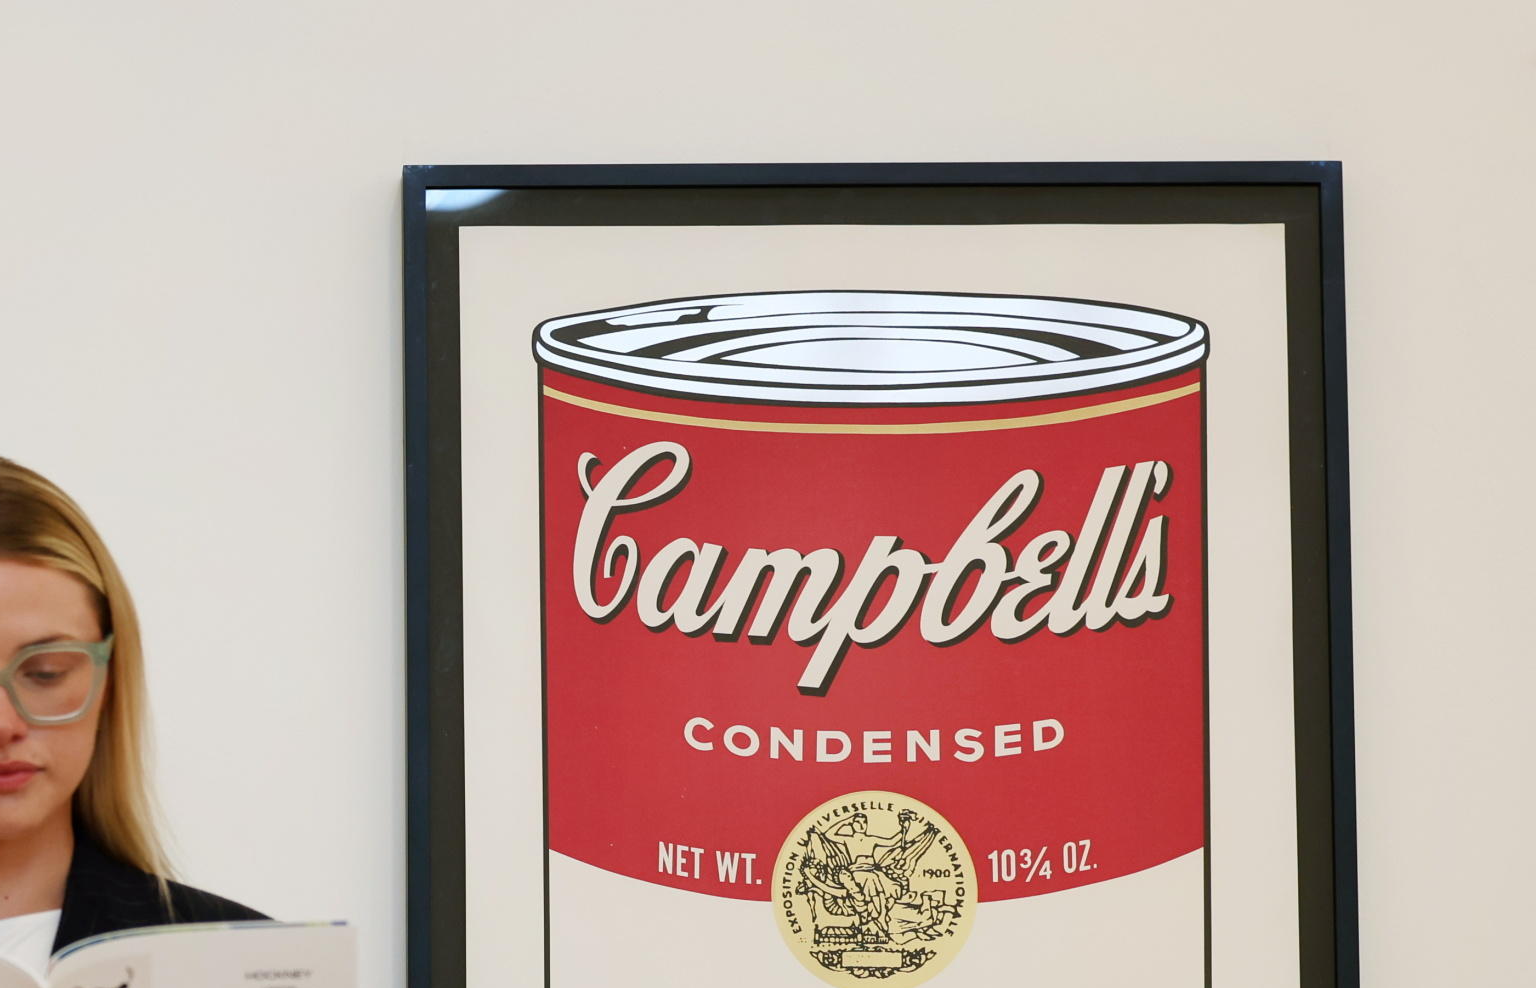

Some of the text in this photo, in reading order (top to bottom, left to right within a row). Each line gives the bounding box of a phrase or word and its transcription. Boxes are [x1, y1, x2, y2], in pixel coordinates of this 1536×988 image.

[573, 441, 1174, 697] Campbell's
[683, 716, 1066, 764] CONDENSED
[657, 841, 763, 886] NET WT.
[923, 868, 951, 879] 1900
[1062, 838, 1099, 875] OZ.
[782, 851, 802, 934] EXPOSITION
